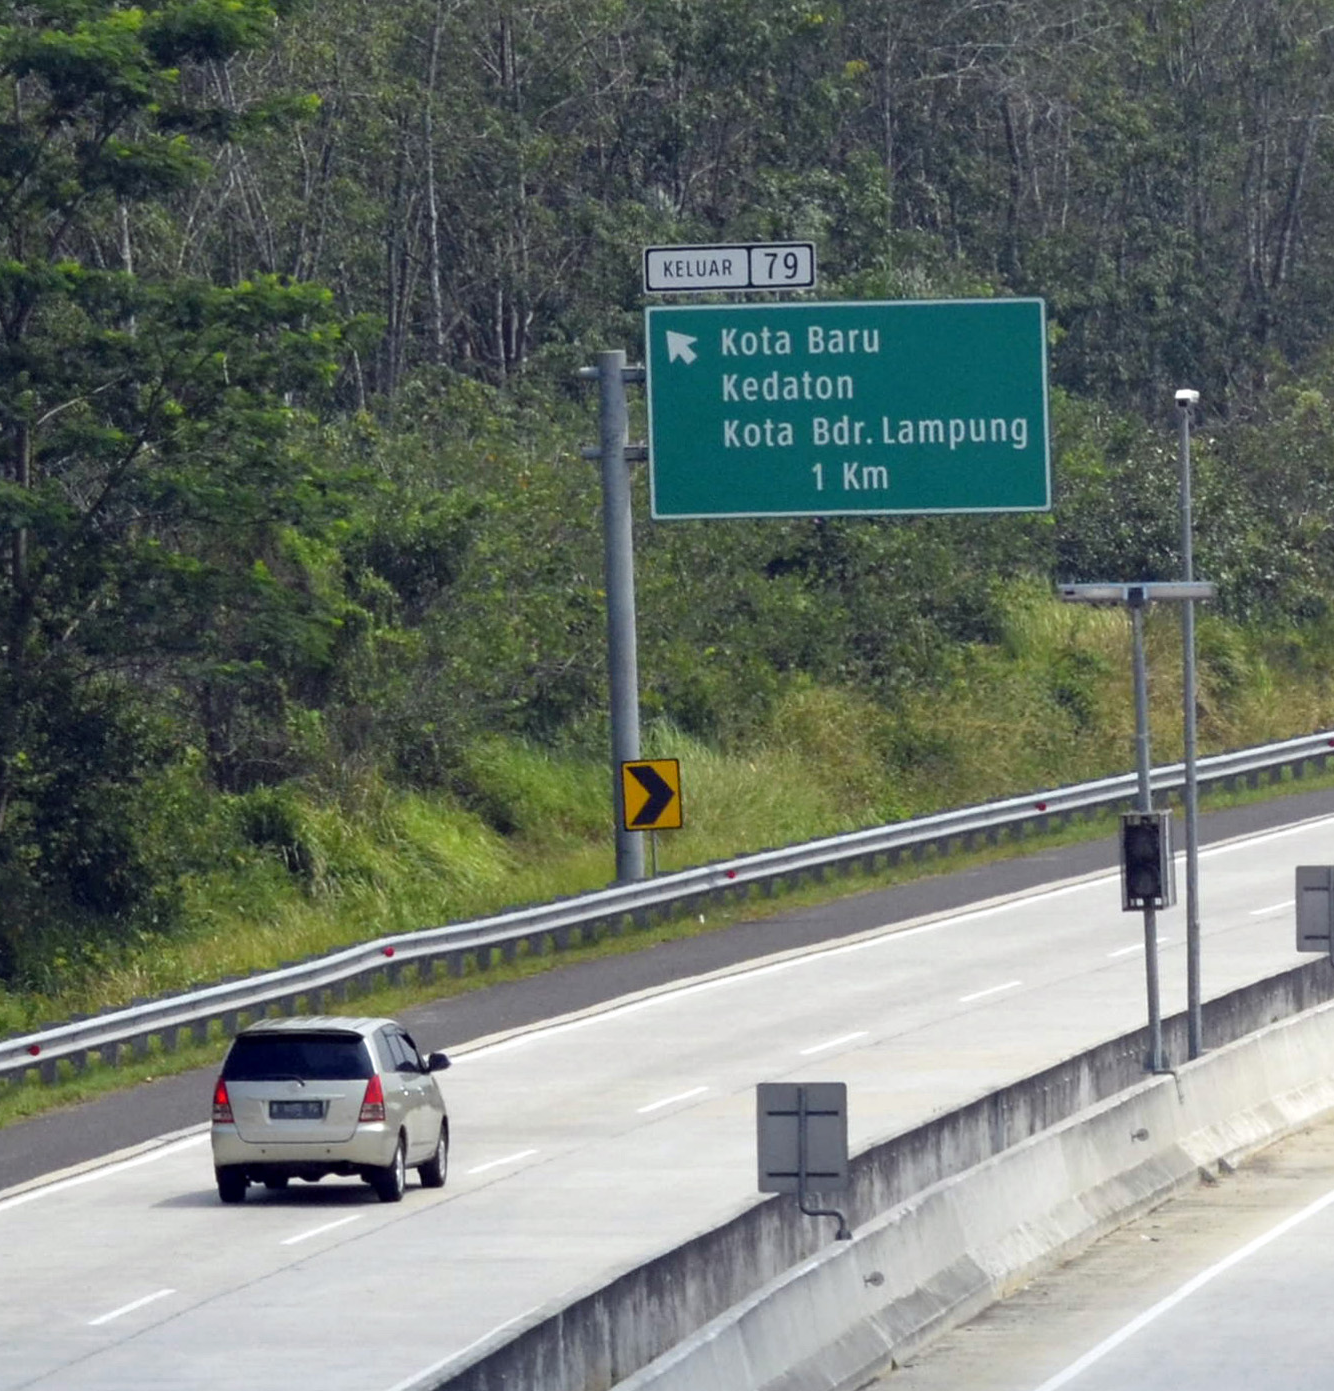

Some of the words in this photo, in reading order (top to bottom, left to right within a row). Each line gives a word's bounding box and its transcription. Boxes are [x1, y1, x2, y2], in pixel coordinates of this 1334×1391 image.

[663, 258, 733, 279] KELUAR
[764, 252, 799, 280] 79
[721, 326, 791, 356] Kota
[807, 325, 880, 355] Baru
[722, 371, 854, 402] Kedaton
[723, 419, 794, 448] Kota
[812, 415, 873, 446] Bdr.
[882, 415, 1028, 450] Lampung
[811, 463, 824, 491] 1
[842, 461, 889, 490] Km
